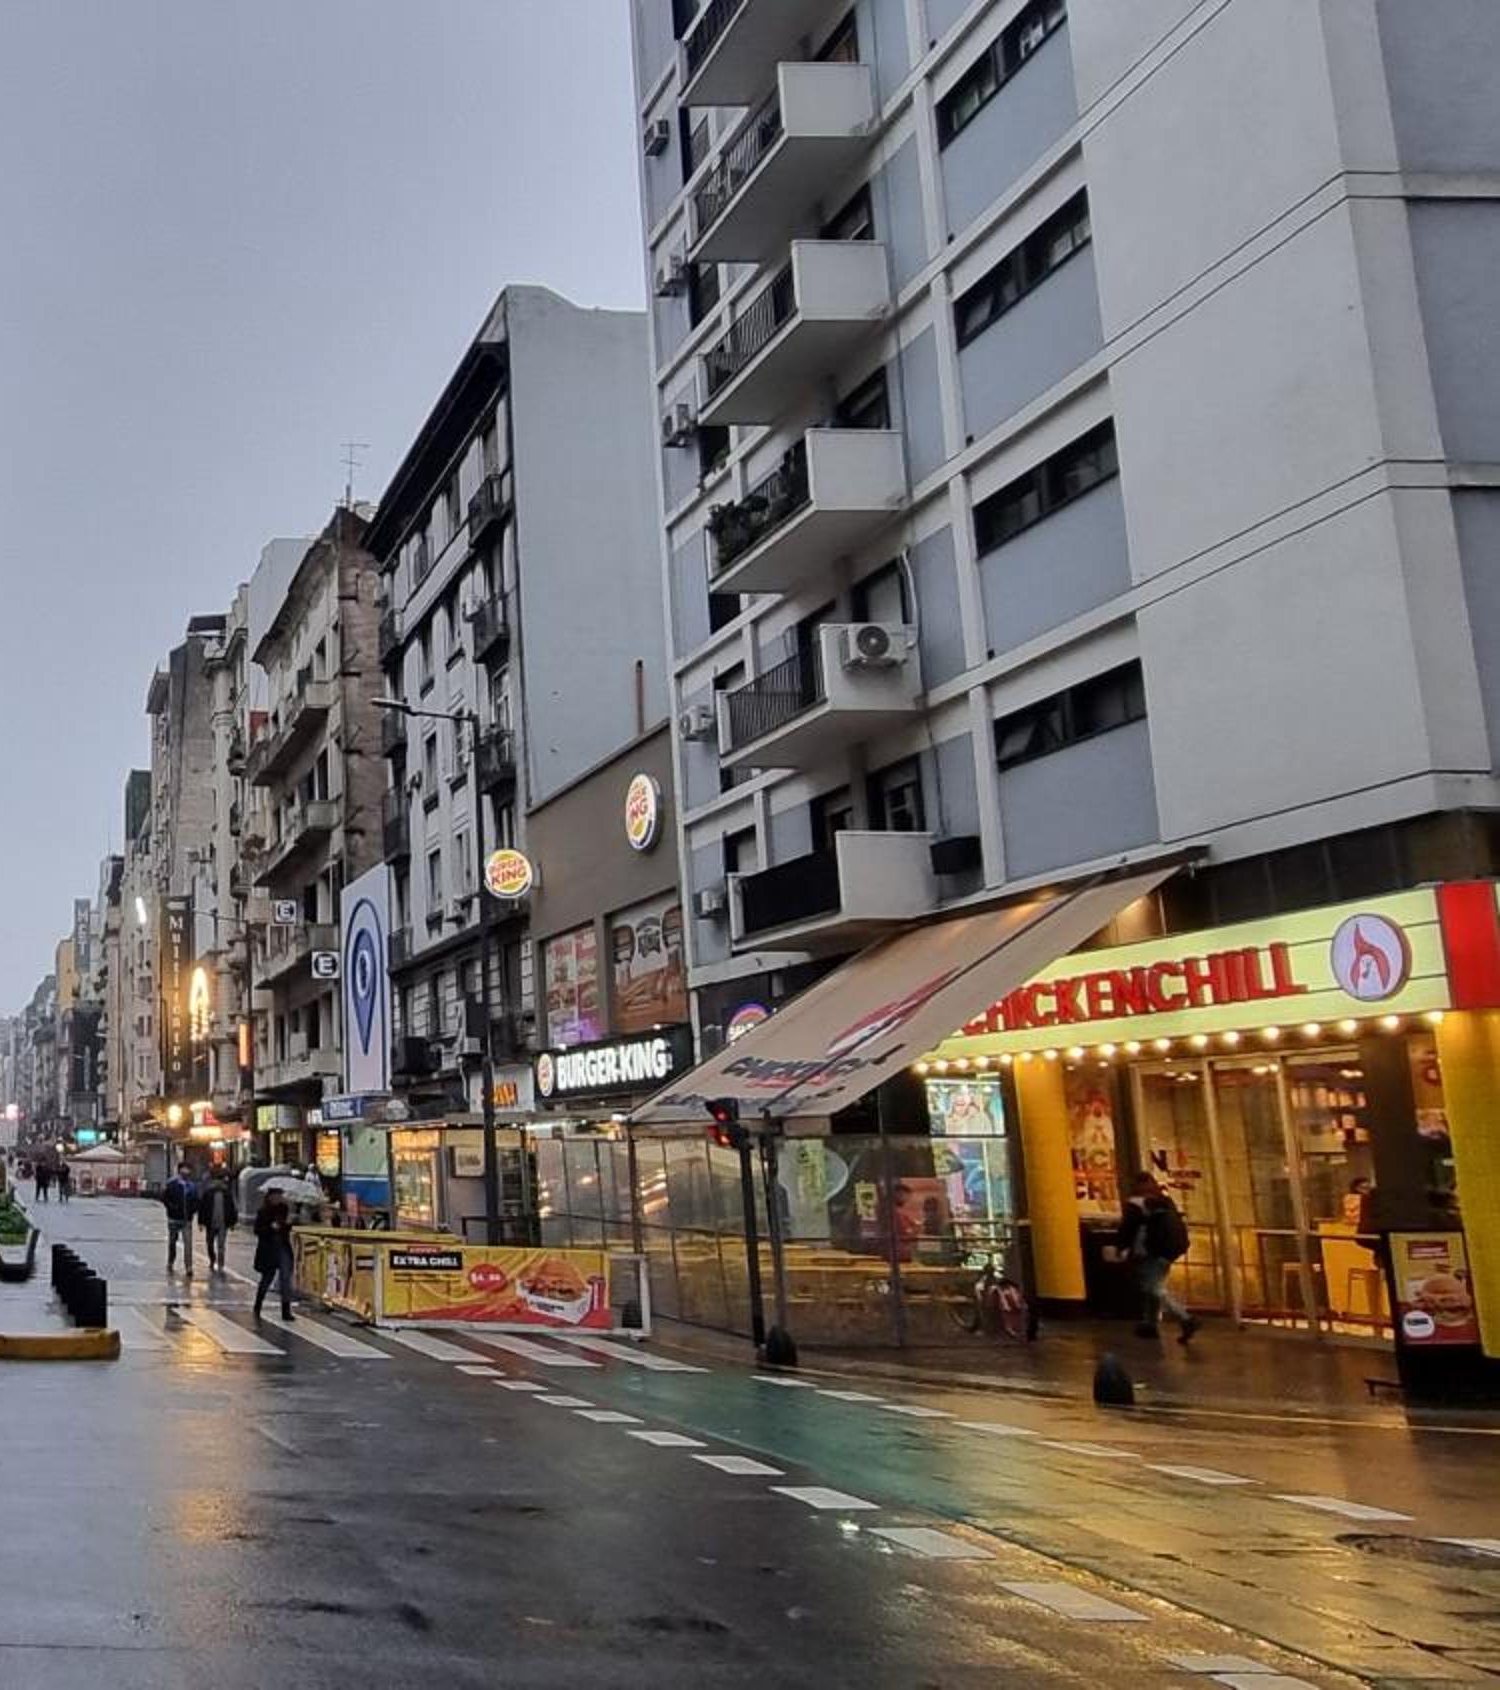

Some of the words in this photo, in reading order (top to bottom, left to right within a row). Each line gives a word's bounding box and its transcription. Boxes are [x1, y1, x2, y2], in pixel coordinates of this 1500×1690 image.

[491, 867, 527, 886] KING
[280, 903, 293, 920] E
[318, 956, 334, 975] E
[393, 1254, 429, 1266] EXTRA
